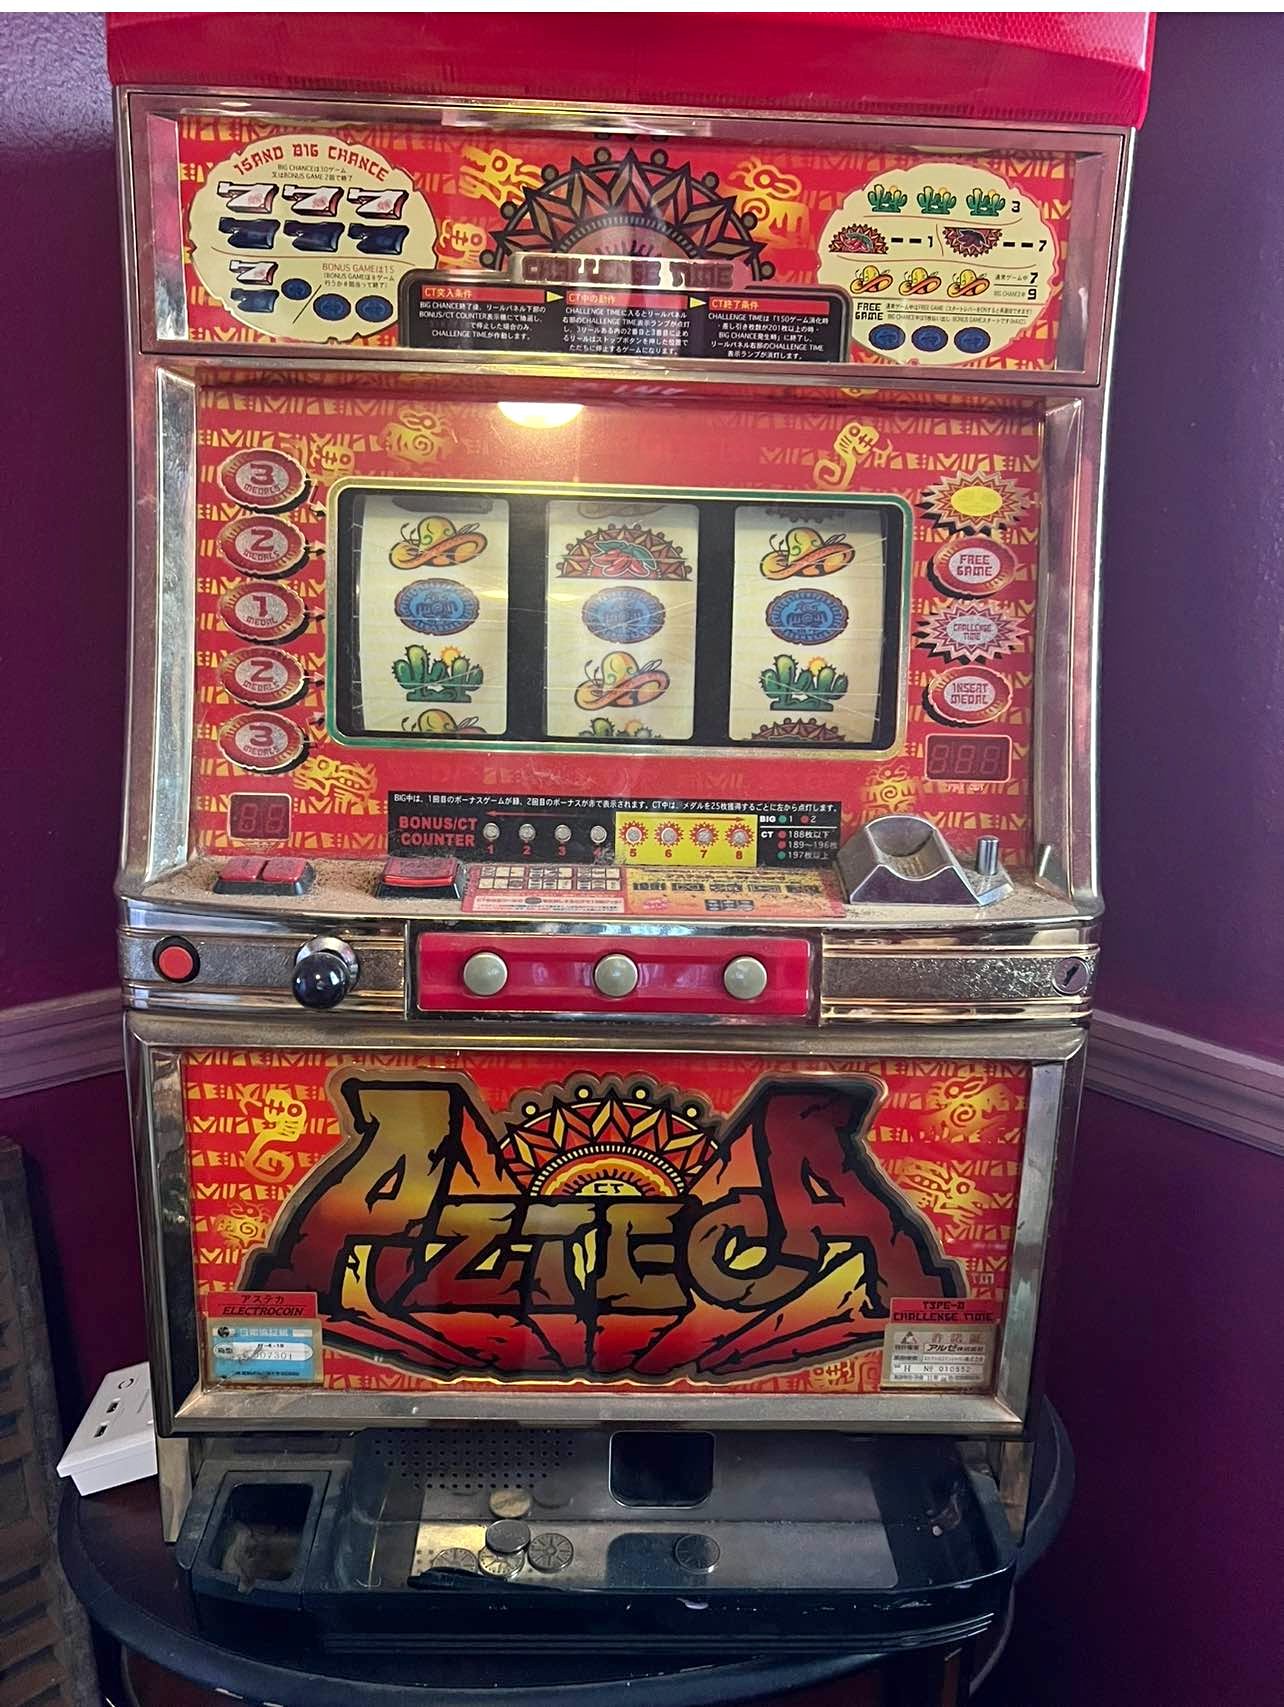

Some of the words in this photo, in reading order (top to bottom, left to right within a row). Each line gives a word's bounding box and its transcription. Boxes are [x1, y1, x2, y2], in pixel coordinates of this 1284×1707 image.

[292, 144, 319, 157] BIG
[328, 146, 389, 182] CHANCE
[1011, 200, 1021, 213] 3
[928, 236, 934, 248] 1
[1038, 240, 1048, 252] 7
[322, 263, 351, 272] BONUS
[1030, 272, 1039, 284] 7
[1027, 288, 1037, 300] 9
[420, 301, 432, 309] BIG
[857, 303, 882, 312] FREE
[419, 310, 454, 319] BONUS/CT
[565, 307, 604, 316] CHALLENGE
[708, 312, 747, 321] CHALLENGE
[855, 311, 884, 321] GAME
[432, 330, 471, 338] CHALLENGE
[809, 344, 824, 352] TIME
[250, 463, 275, 486] 3
[243, 482, 281, 496] MEDALS
[250, 529, 274, 552] 2
[243, 549, 281, 562] MEDALS
[959, 554, 991, 566] FREE
[956, 566, 993, 577] GAME
[252, 595, 268, 618] 1
[246, 615, 278, 626] MEDAL
[953, 623, 992, 633] CHALLENGE
[963, 632, 982, 640] TIME
[250, 660, 275, 683] 2
[243, 680, 281, 693] MEDALS
[952, 682, 989, 693] INSERT
[950, 694, 989, 704] MEDAL
[249, 725, 274, 747] 3
[243, 744, 281, 757] MEDALS
[399, 815, 479, 832] BONUS/CT
[759, 815, 777, 824] BIG
[788, 815, 793, 824] 1
[810, 815, 817, 824] 2
[400, 832, 476, 848] COUNTER
[760, 831, 774, 839] CT
[487, 844, 494, 855] 1
[522, 845, 531, 856] 2
[558, 846, 567, 857] 3
[629, 848, 638, 858] 5
[664, 848, 673, 859] 6
[700, 849, 709, 859] 7
[735, 849, 744, 860] 8
[593, 1183, 625, 1194] CT
[240, 1078, 968, 1325] AZTECA
[240, 1294, 285, 1305] アステカ
[222, 1305, 305, 1317] ELECTROCOIN
[893, 1311, 958, 1321] CHALLENGE
[963, 1312, 994, 1322] TIME
